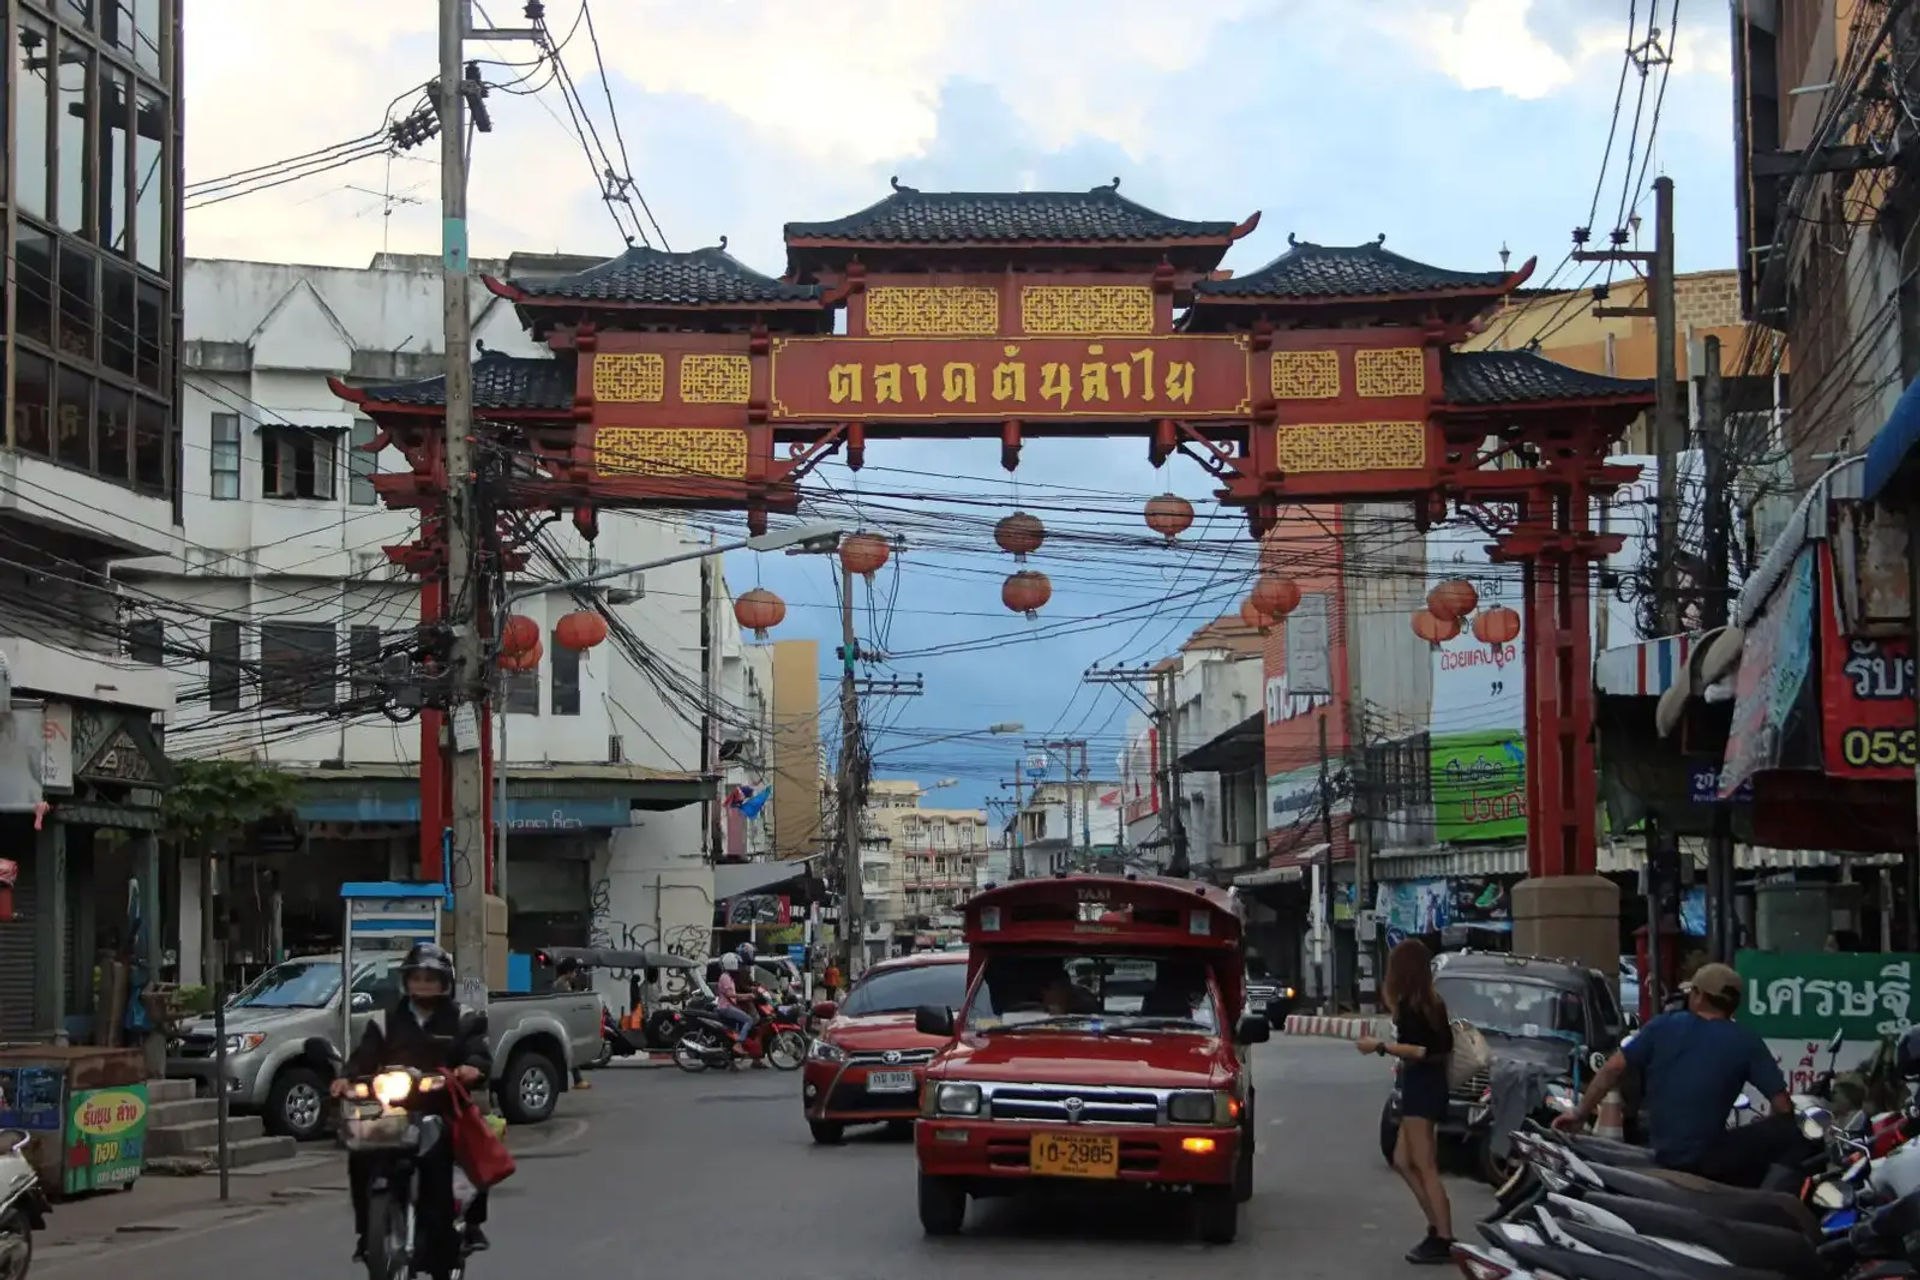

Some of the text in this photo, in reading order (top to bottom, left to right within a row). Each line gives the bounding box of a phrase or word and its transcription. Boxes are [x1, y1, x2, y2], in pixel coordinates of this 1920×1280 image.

[827, 344, 1196, 410] ตลาดต้นลำไย
[1748, 960, 1912, 1036] เศรษฐี
